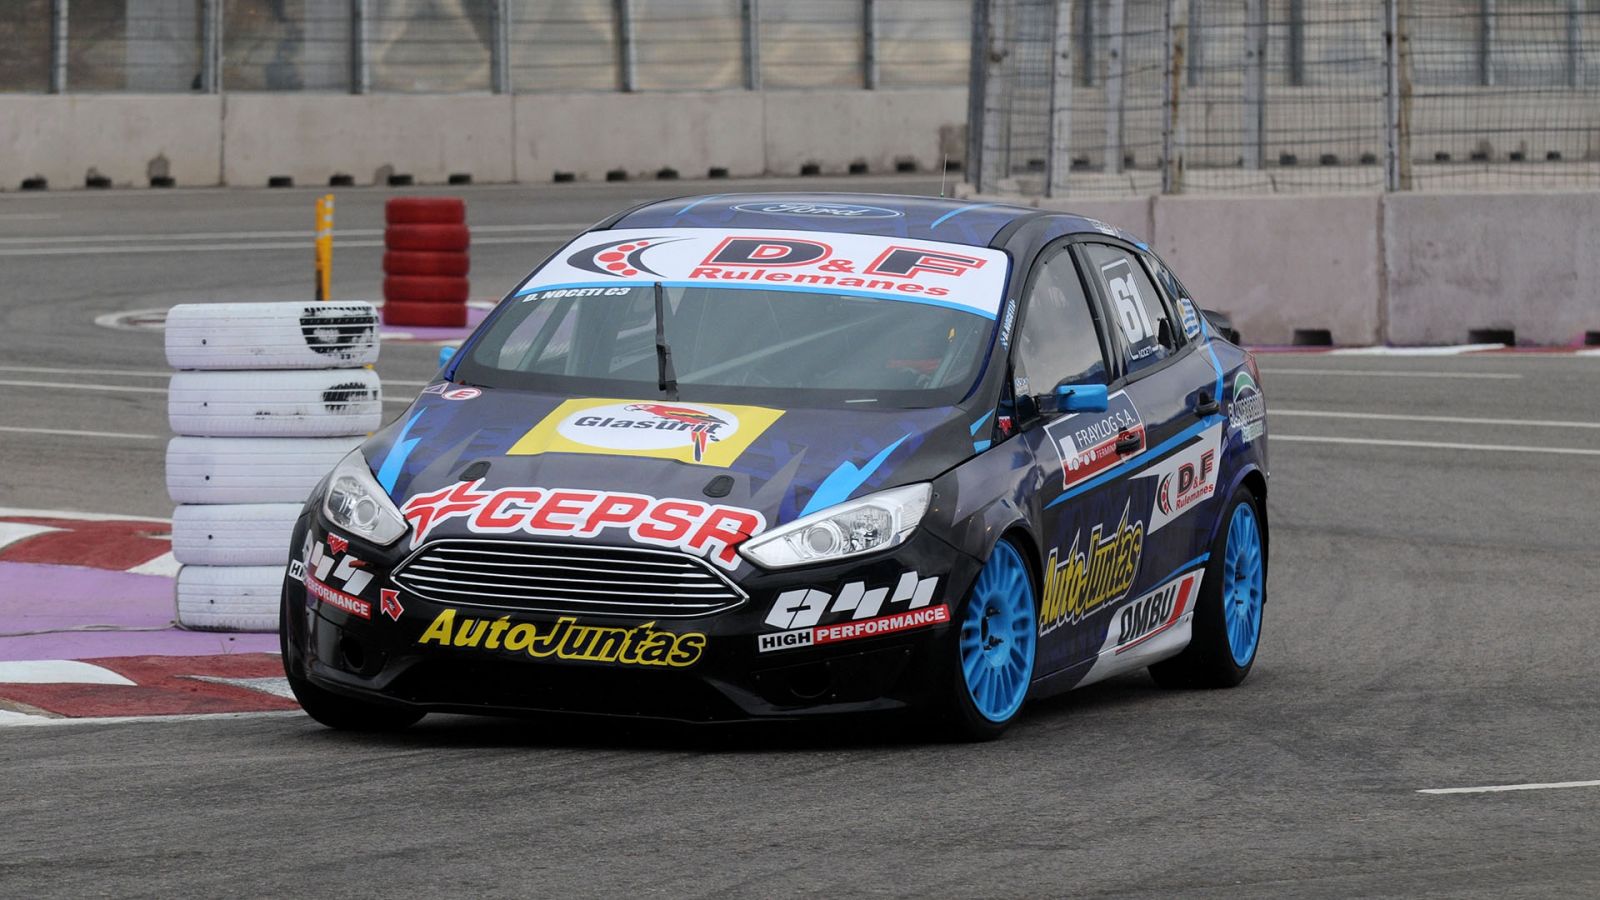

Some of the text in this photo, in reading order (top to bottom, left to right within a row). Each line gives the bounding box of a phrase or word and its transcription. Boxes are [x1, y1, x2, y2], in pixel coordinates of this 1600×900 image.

[541, 288, 604, 300] NOCETI
[604, 287, 631, 296] C3
[688, 267, 950, 297] Rulemanes
[1109, 272, 1153, 344] 61
[574, 416, 723, 435] Glasurit
[1075, 408, 1136, 448] FRAYLOG S.A.
[1176, 483, 1213, 510] Rulemanes
[1040, 496, 1144, 637] AutoJuntas
[762, 607, 946, 649] HIGH PERFORMANCE
[1118, 585, 1176, 644] OMBU
[418, 608, 707, 668] AutoJuntas
